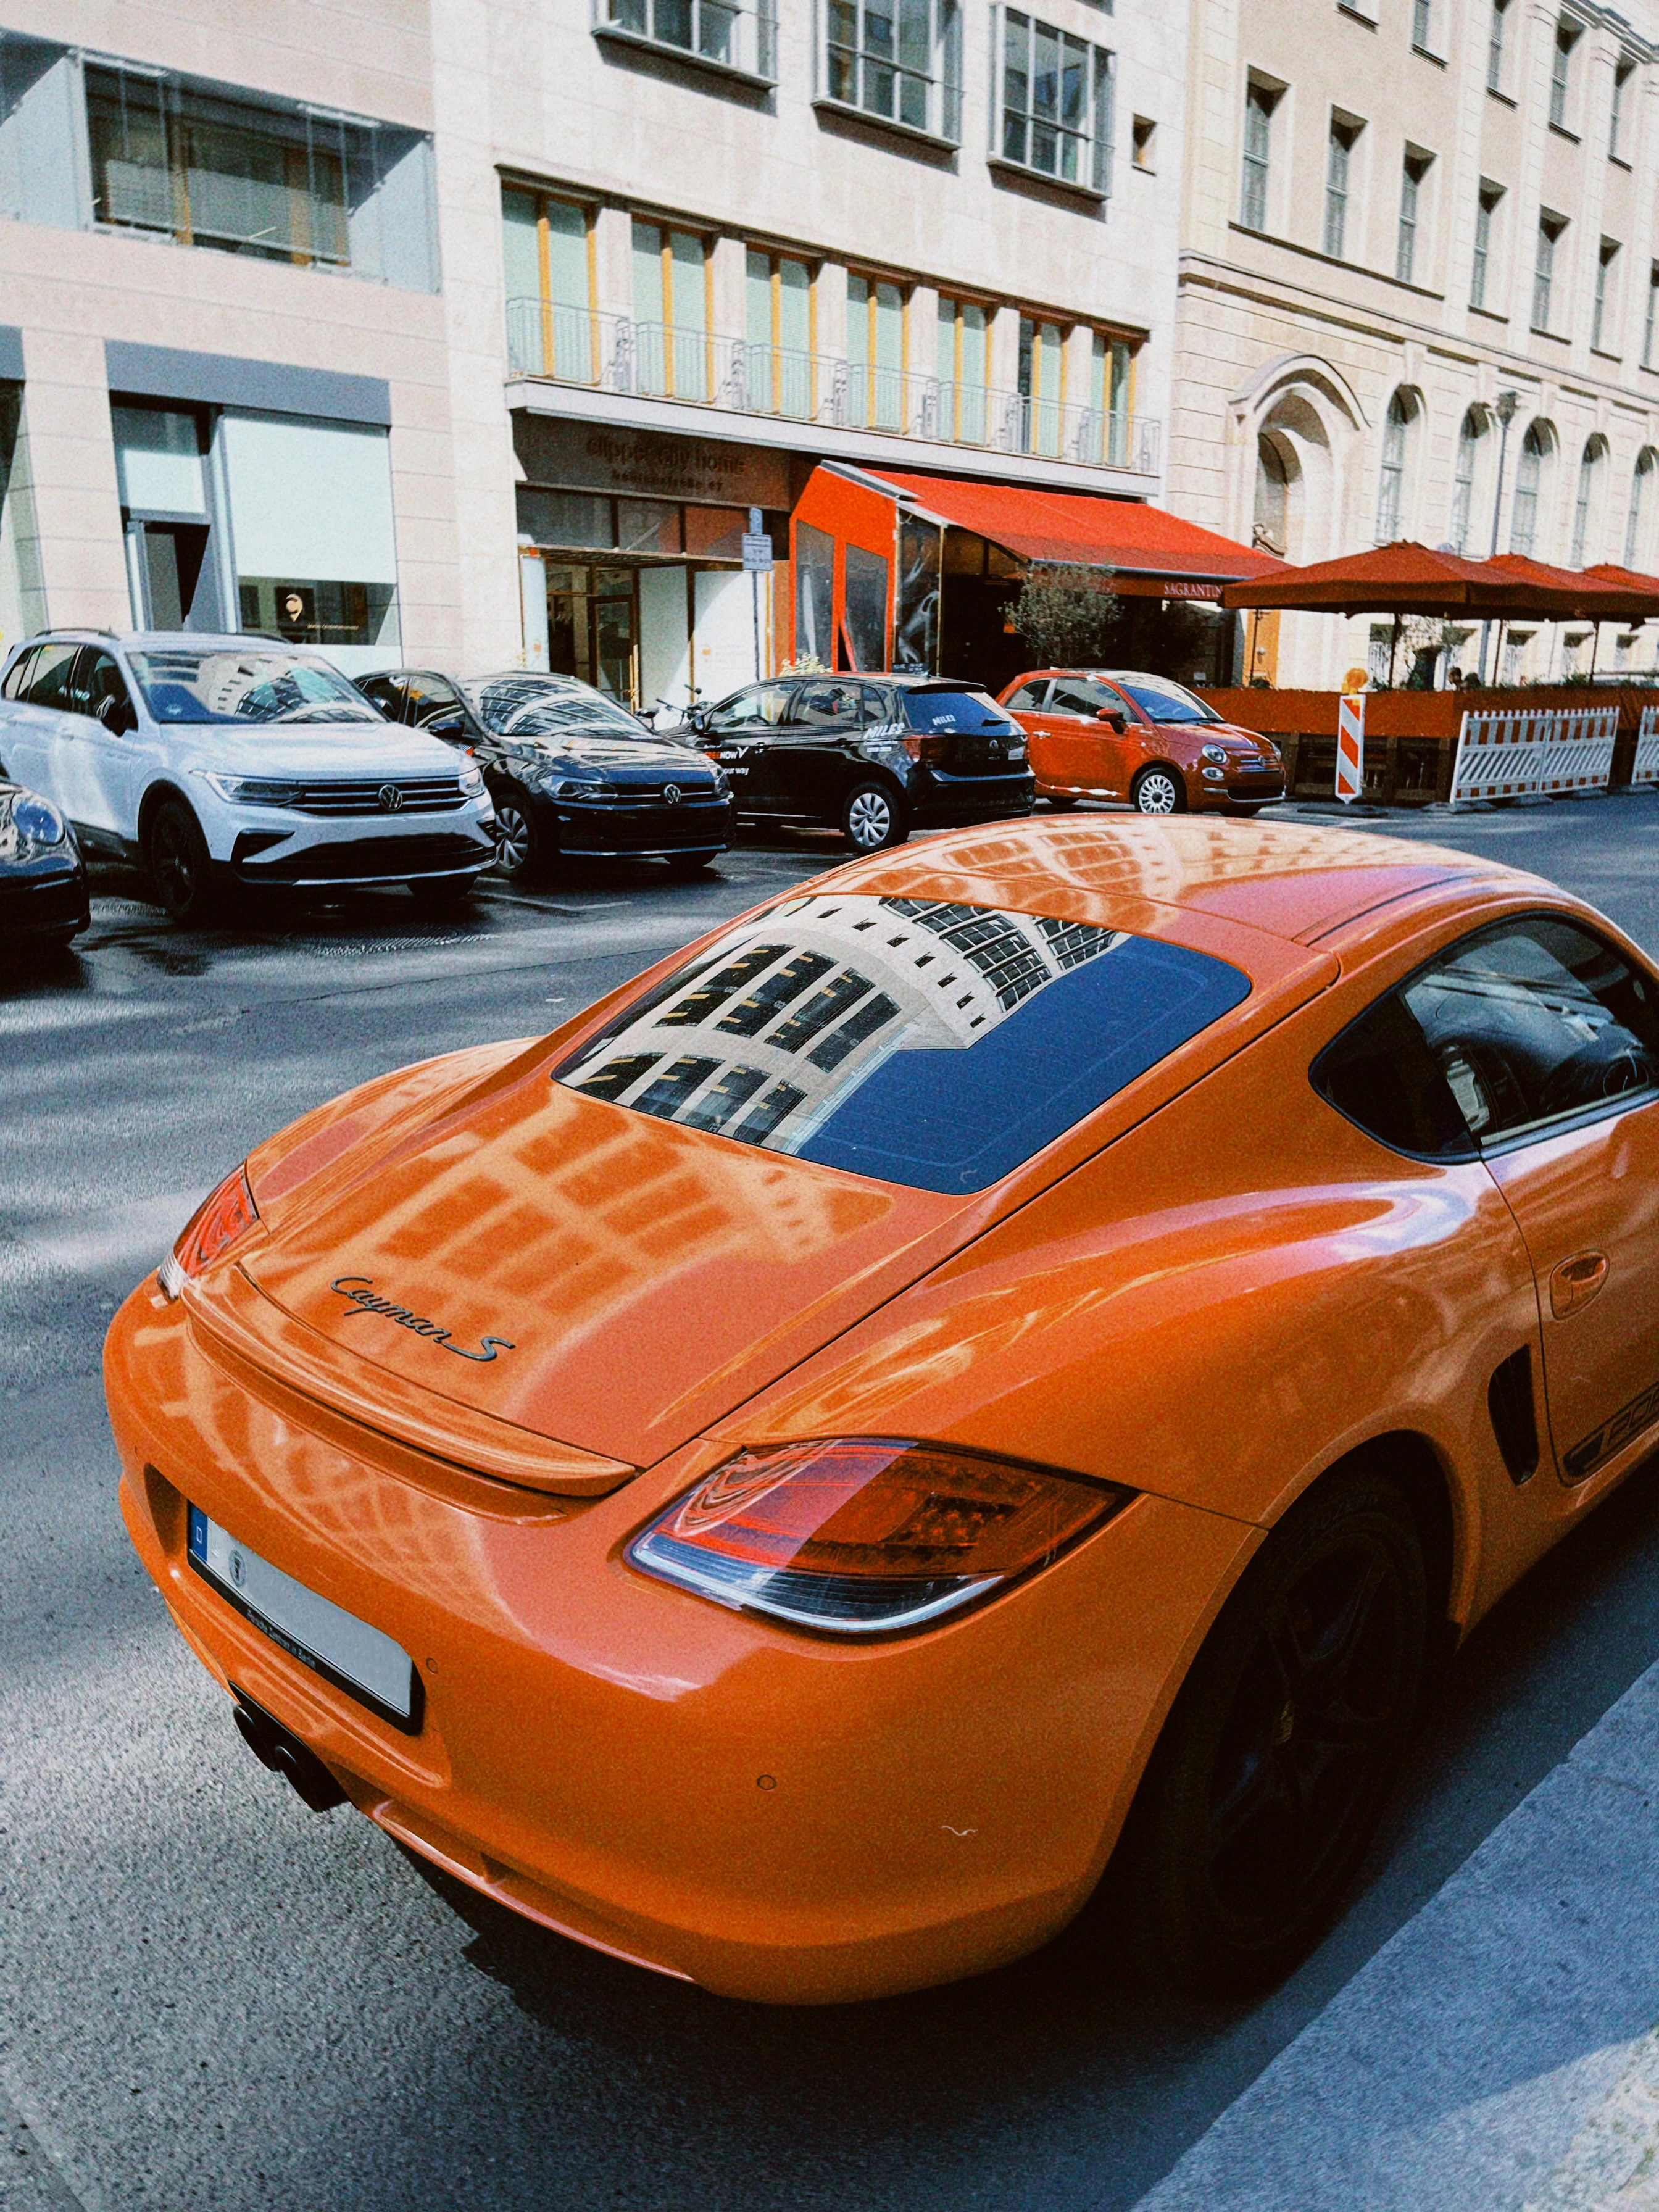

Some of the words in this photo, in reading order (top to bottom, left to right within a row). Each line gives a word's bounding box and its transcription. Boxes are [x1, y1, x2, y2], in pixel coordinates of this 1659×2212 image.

[1164, 581, 1223, 598] SAGRANTIN
[932, 714, 956, 726] MILES
[863, 723, 905, 739] MILES
[331, 1276, 452, 1344] Cayman
[442, 1336, 516, 1362] S
